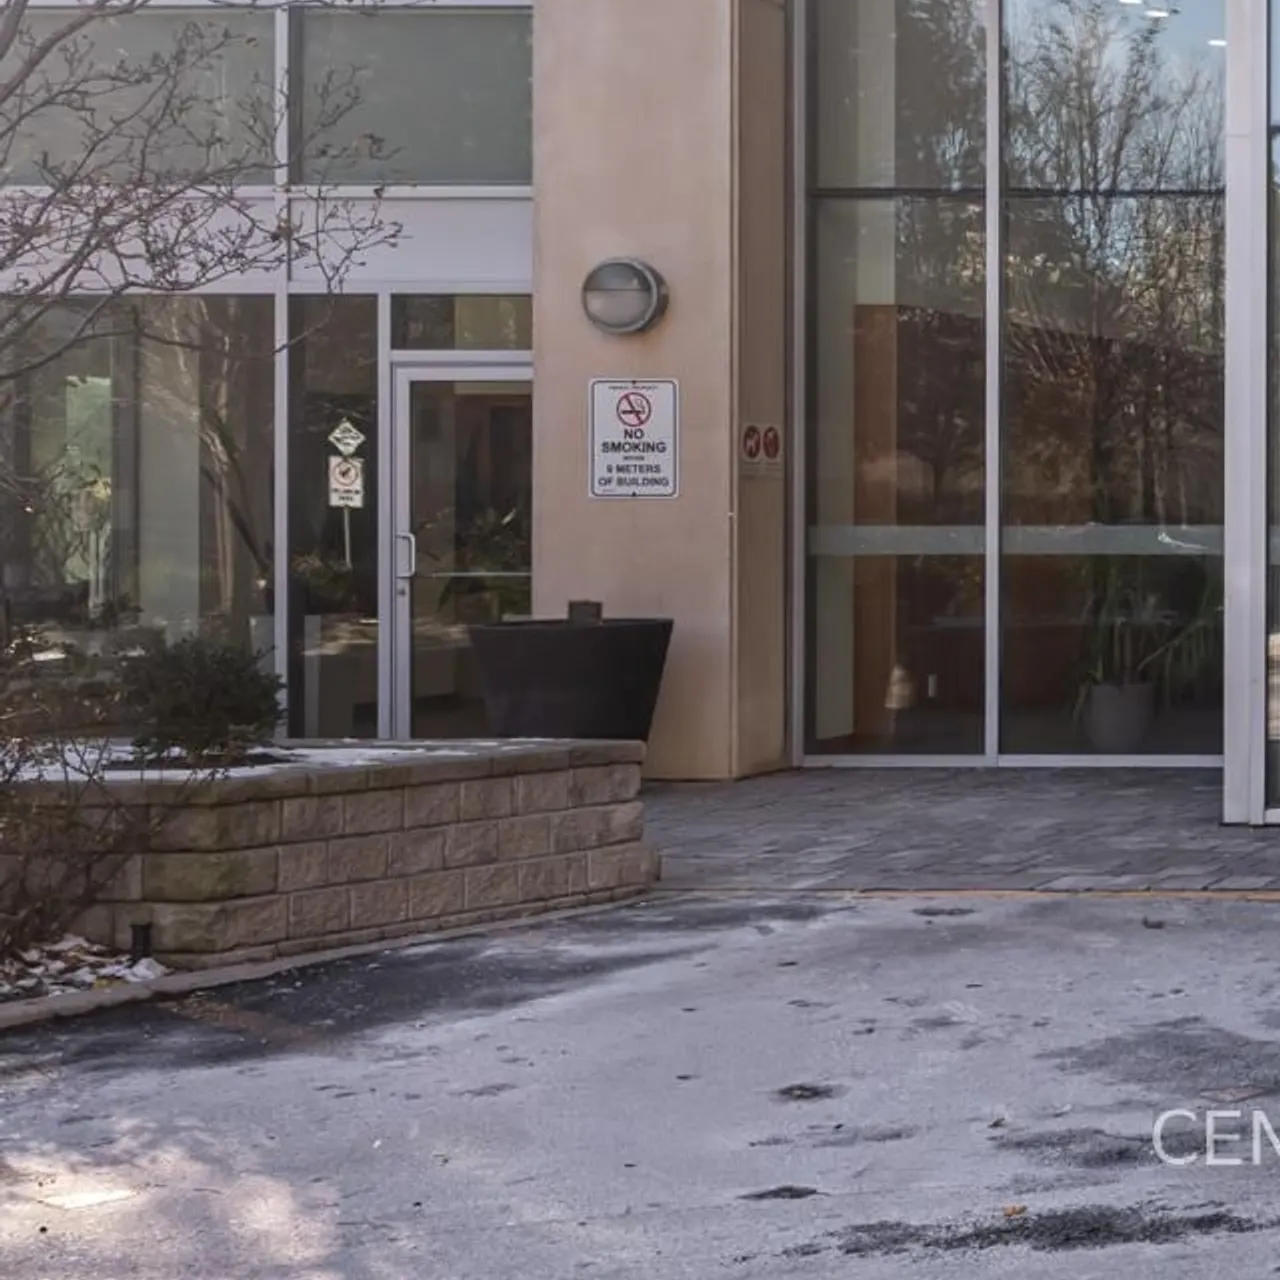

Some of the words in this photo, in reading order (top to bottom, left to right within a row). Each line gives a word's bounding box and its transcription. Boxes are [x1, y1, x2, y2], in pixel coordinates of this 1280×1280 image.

[624, 428, 644, 440] NO
[601, 442, 667, 453] SMOKING
[616, 464, 661, 473] METERS
[598, 477, 612, 487] OF
[617, 477, 669, 487] BUILDING
